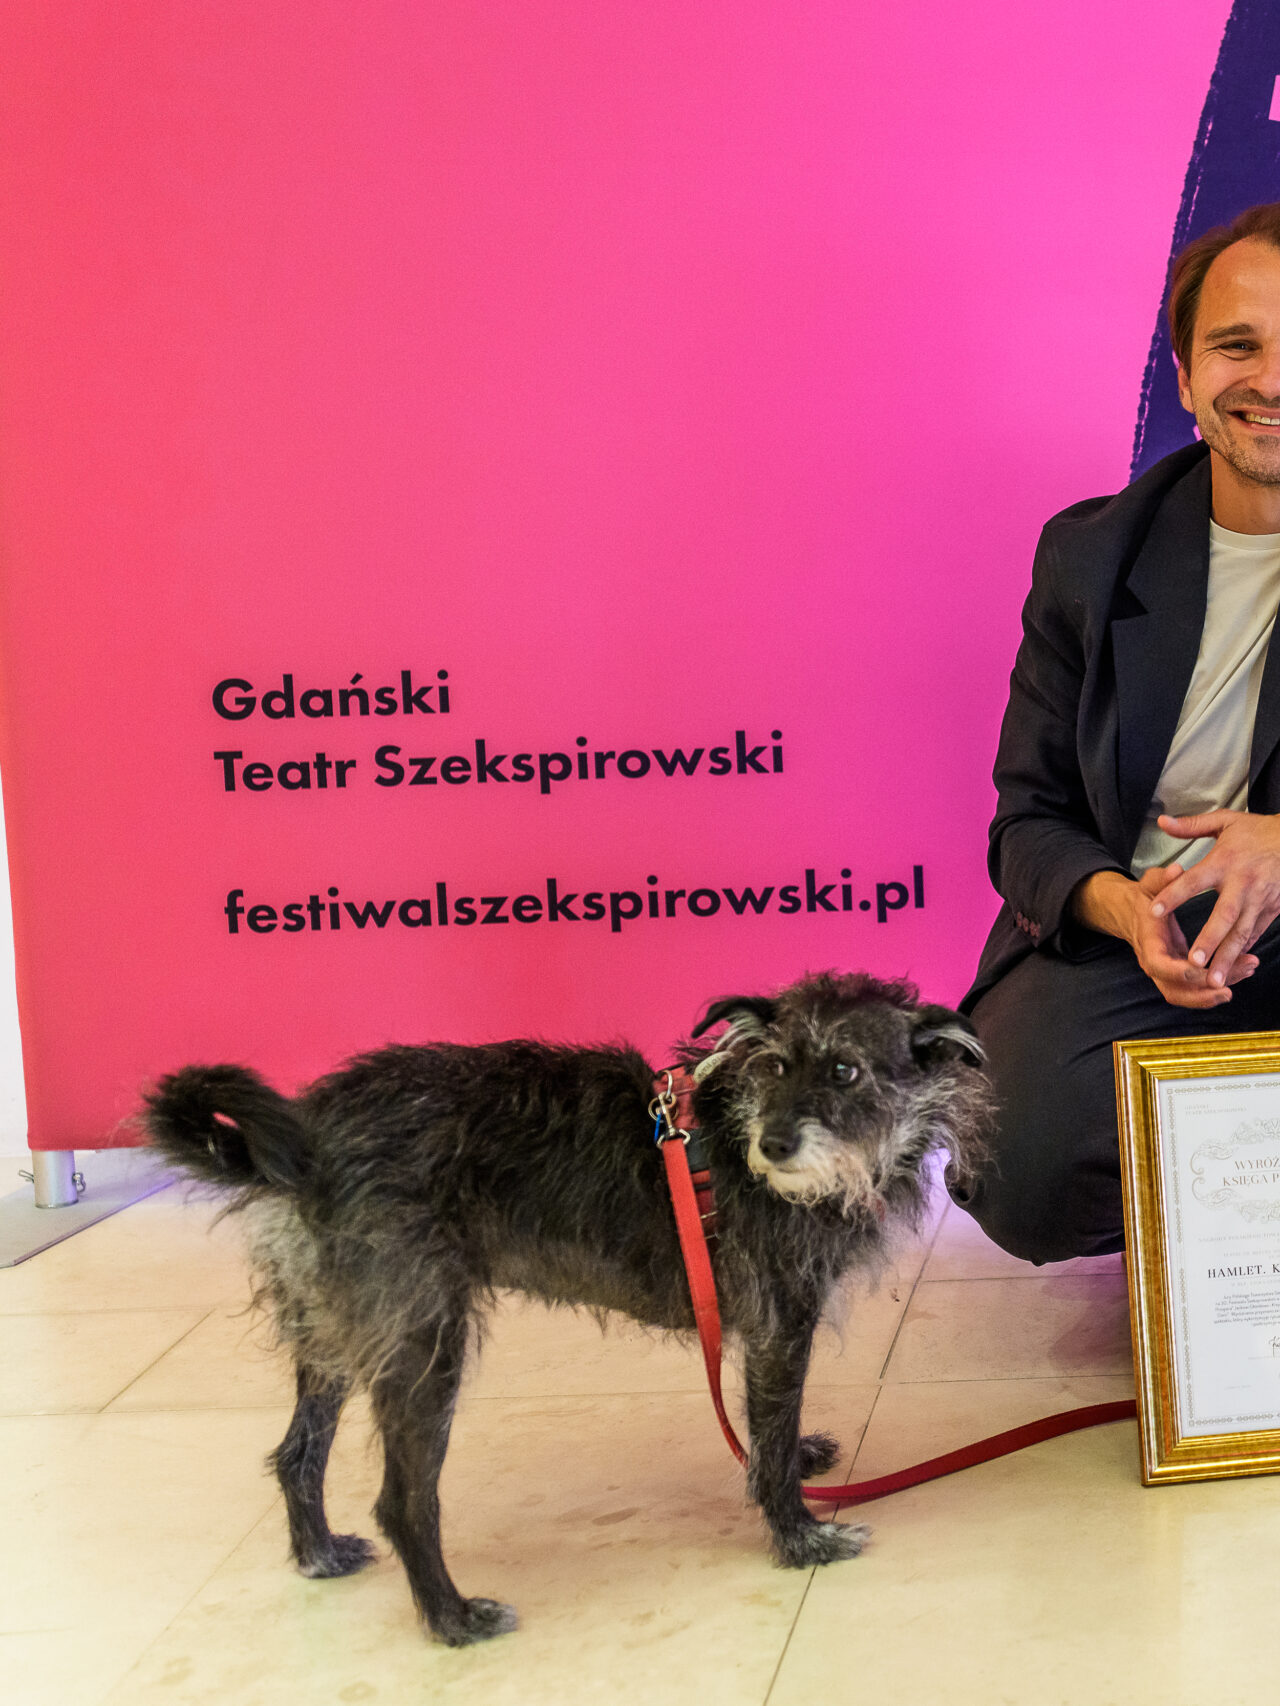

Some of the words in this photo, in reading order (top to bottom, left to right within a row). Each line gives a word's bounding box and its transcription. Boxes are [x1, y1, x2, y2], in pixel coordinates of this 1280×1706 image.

[212, 669, 450, 721] Gdański
[213, 750, 357, 792] Teatr
[373, 730, 785, 795] Szekspirowski
[224, 864, 925, 934] festiwalszekspirowski.pl
[1222, 1173, 1269, 1188] KSIĘGA
[1207, 1264, 1267, 1279] HAMLET.
